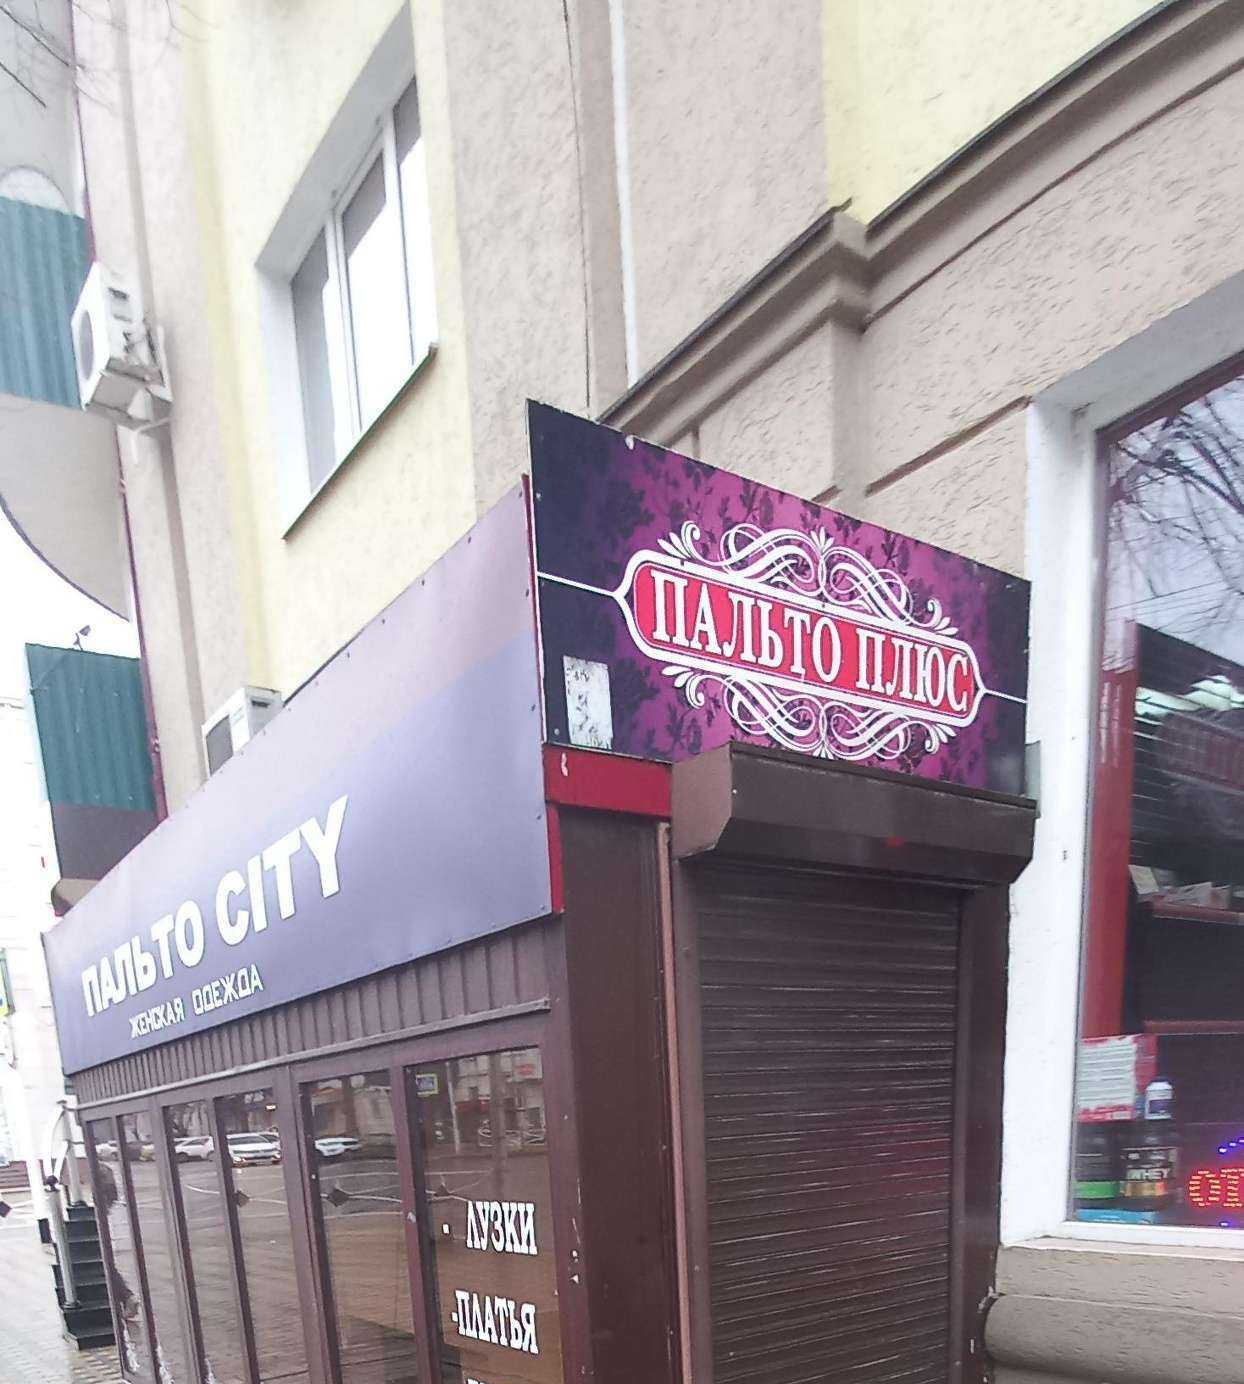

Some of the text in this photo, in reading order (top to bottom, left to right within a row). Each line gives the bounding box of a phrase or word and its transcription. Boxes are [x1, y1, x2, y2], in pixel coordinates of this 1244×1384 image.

[651, 570, 970, 712] ПАЛЬТО ПЛЮС
[81, 794, 348, 1017] ПАЛЬТО CITY
[130, 964, 264, 1039] ЖЕНСКАЯ ОДЕЖДА
